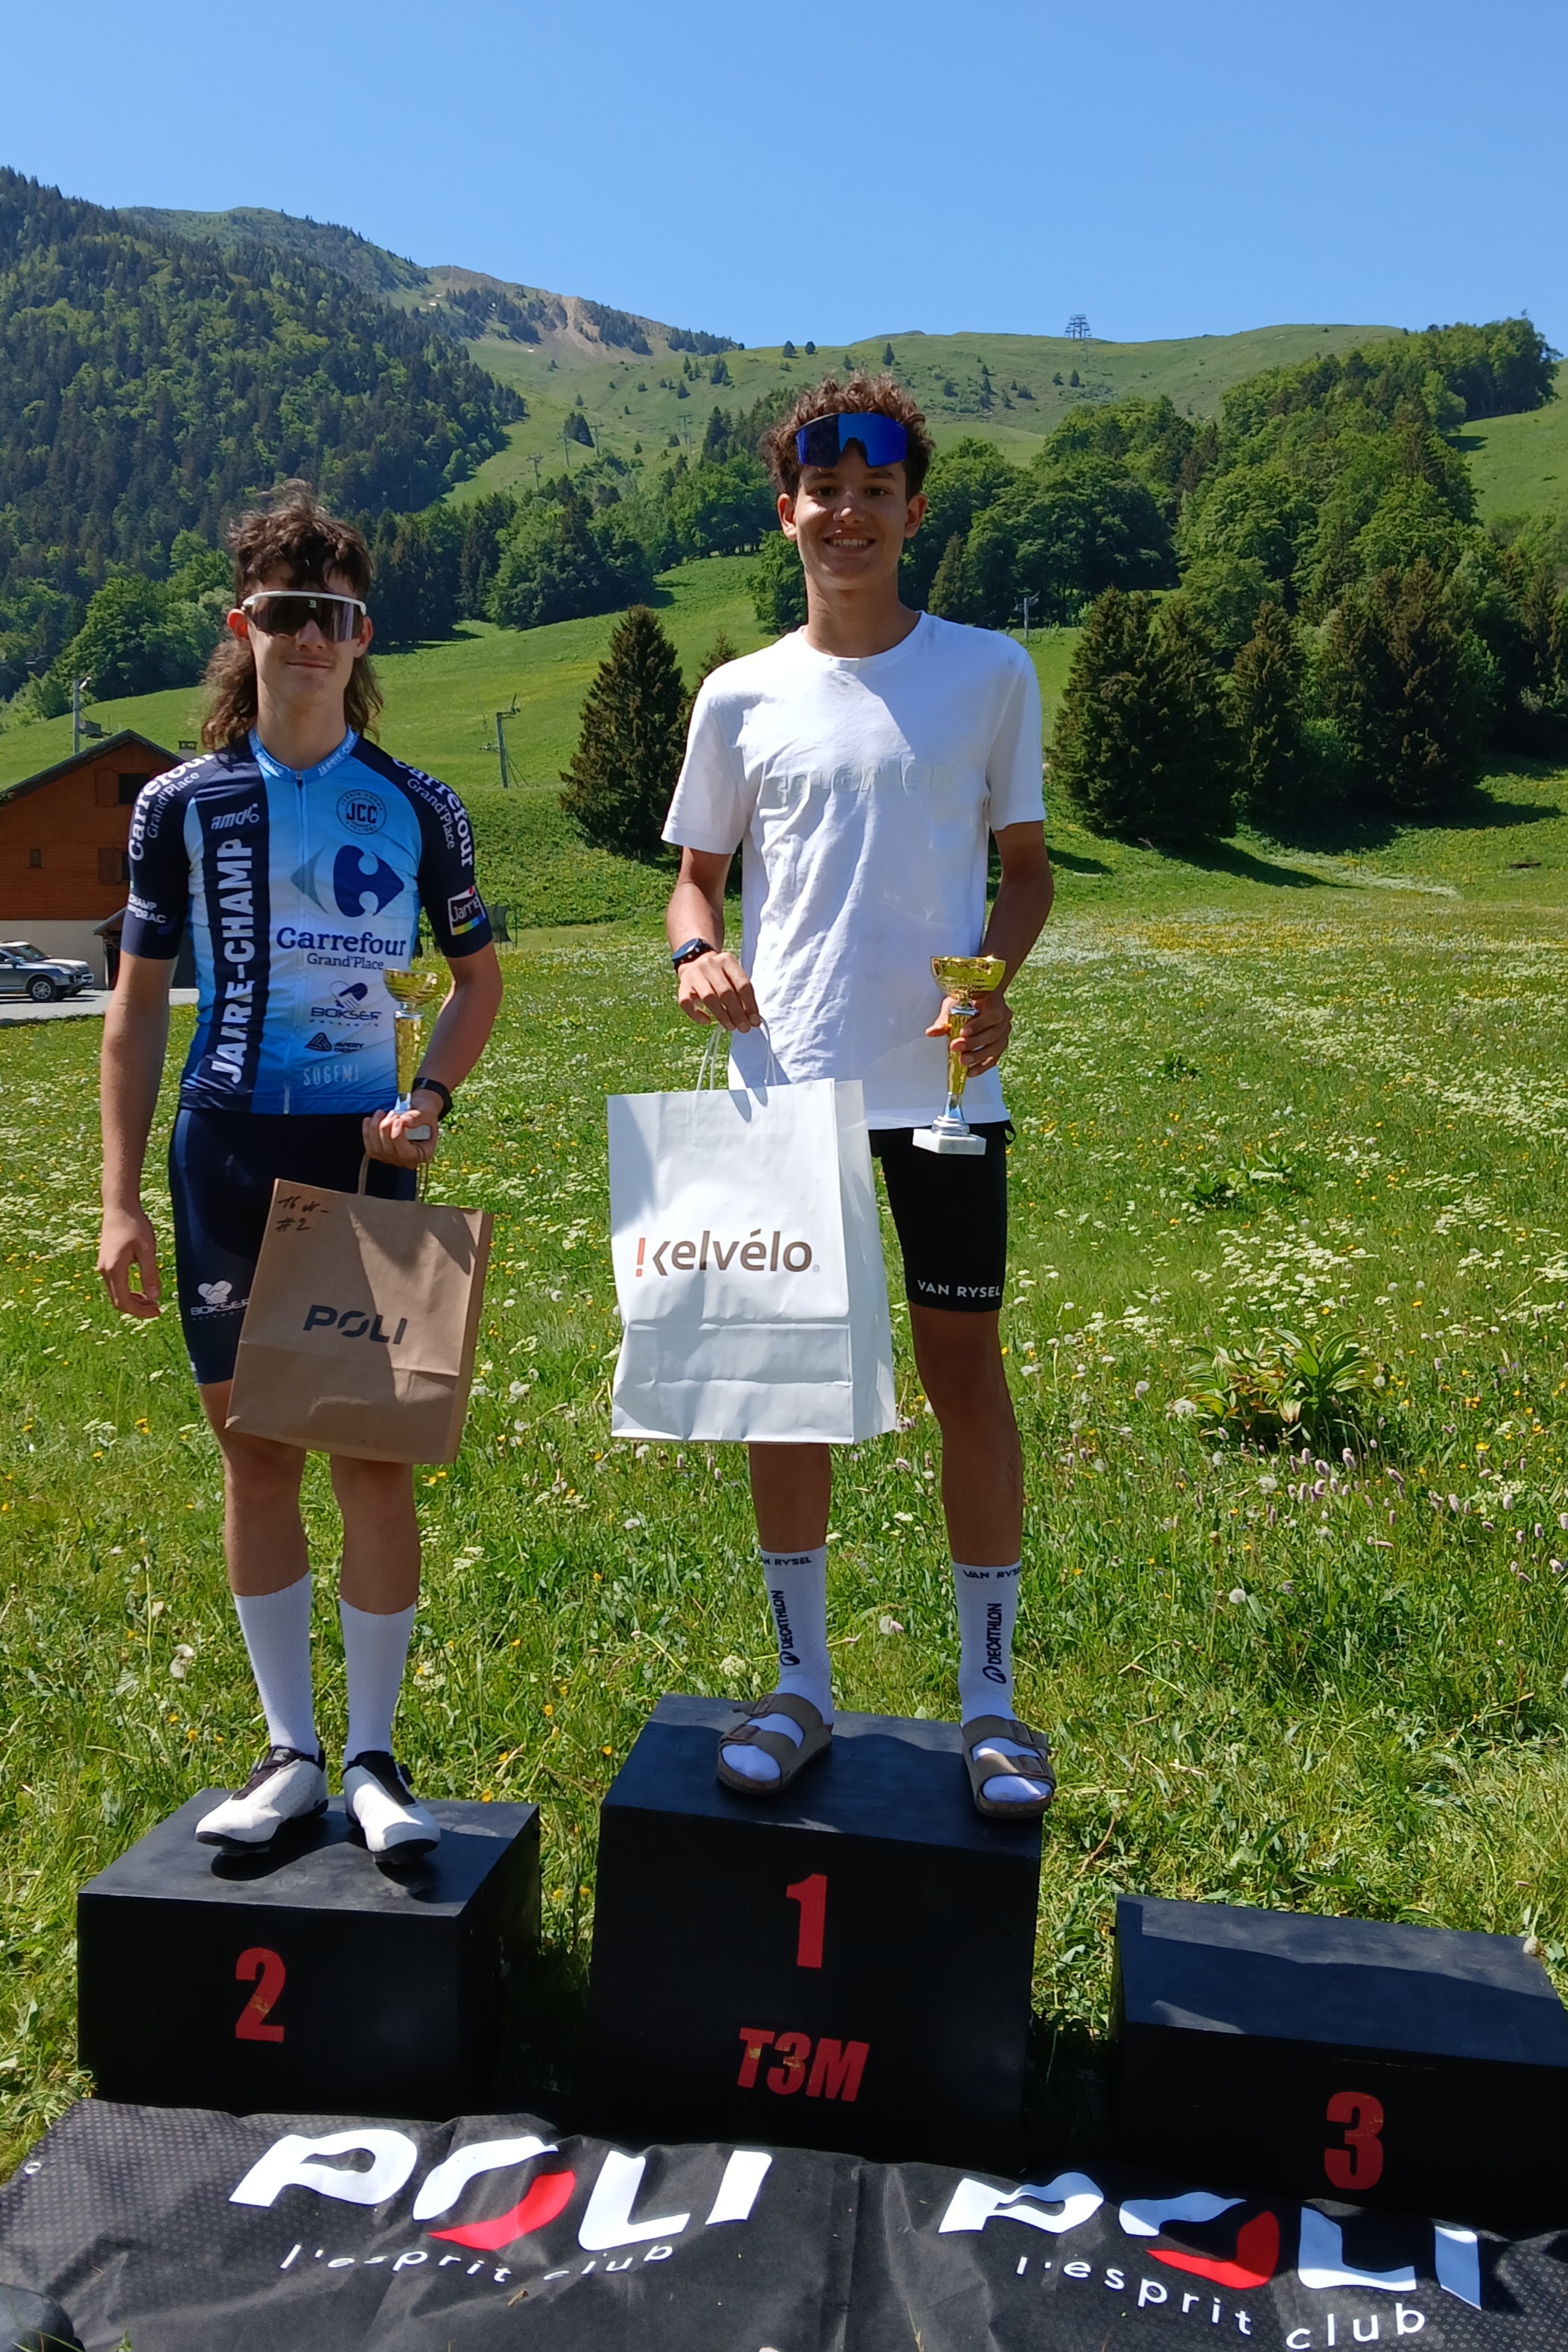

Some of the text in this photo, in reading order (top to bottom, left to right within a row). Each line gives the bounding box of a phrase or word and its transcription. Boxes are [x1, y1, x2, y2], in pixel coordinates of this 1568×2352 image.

[346, 802, 378, 824] JCC
[407, 778, 456, 849] Grand'Place
[276, 926, 407, 957] Carrefour
[306, 952, 384, 970] Grand'Place
[917, 1279, 1001, 1298] VAN RYSEL
[302, 1305, 407, 1345] POLI
[775, 1556, 813, 1566] RYSEL
[962, 1566, 1021, 1579] VAN RYS
[770, 1590, 794, 1650] DECATHLON
[985, 1603, 1003, 1665] DECATHLON
[786, 1872, 828, 1969] 1
[235, 1946, 287, 2043] 2
[737, 2026, 870, 2102] T3M
[1324, 2091, 1385, 2190] 3
[229, 2128, 772, 2251] POLI
[280, 2243, 674, 2283] l'esprit club
[938, 2172, 1482, 2312] POLI
[1015, 2256, 1426, 2351] l'esprit club
